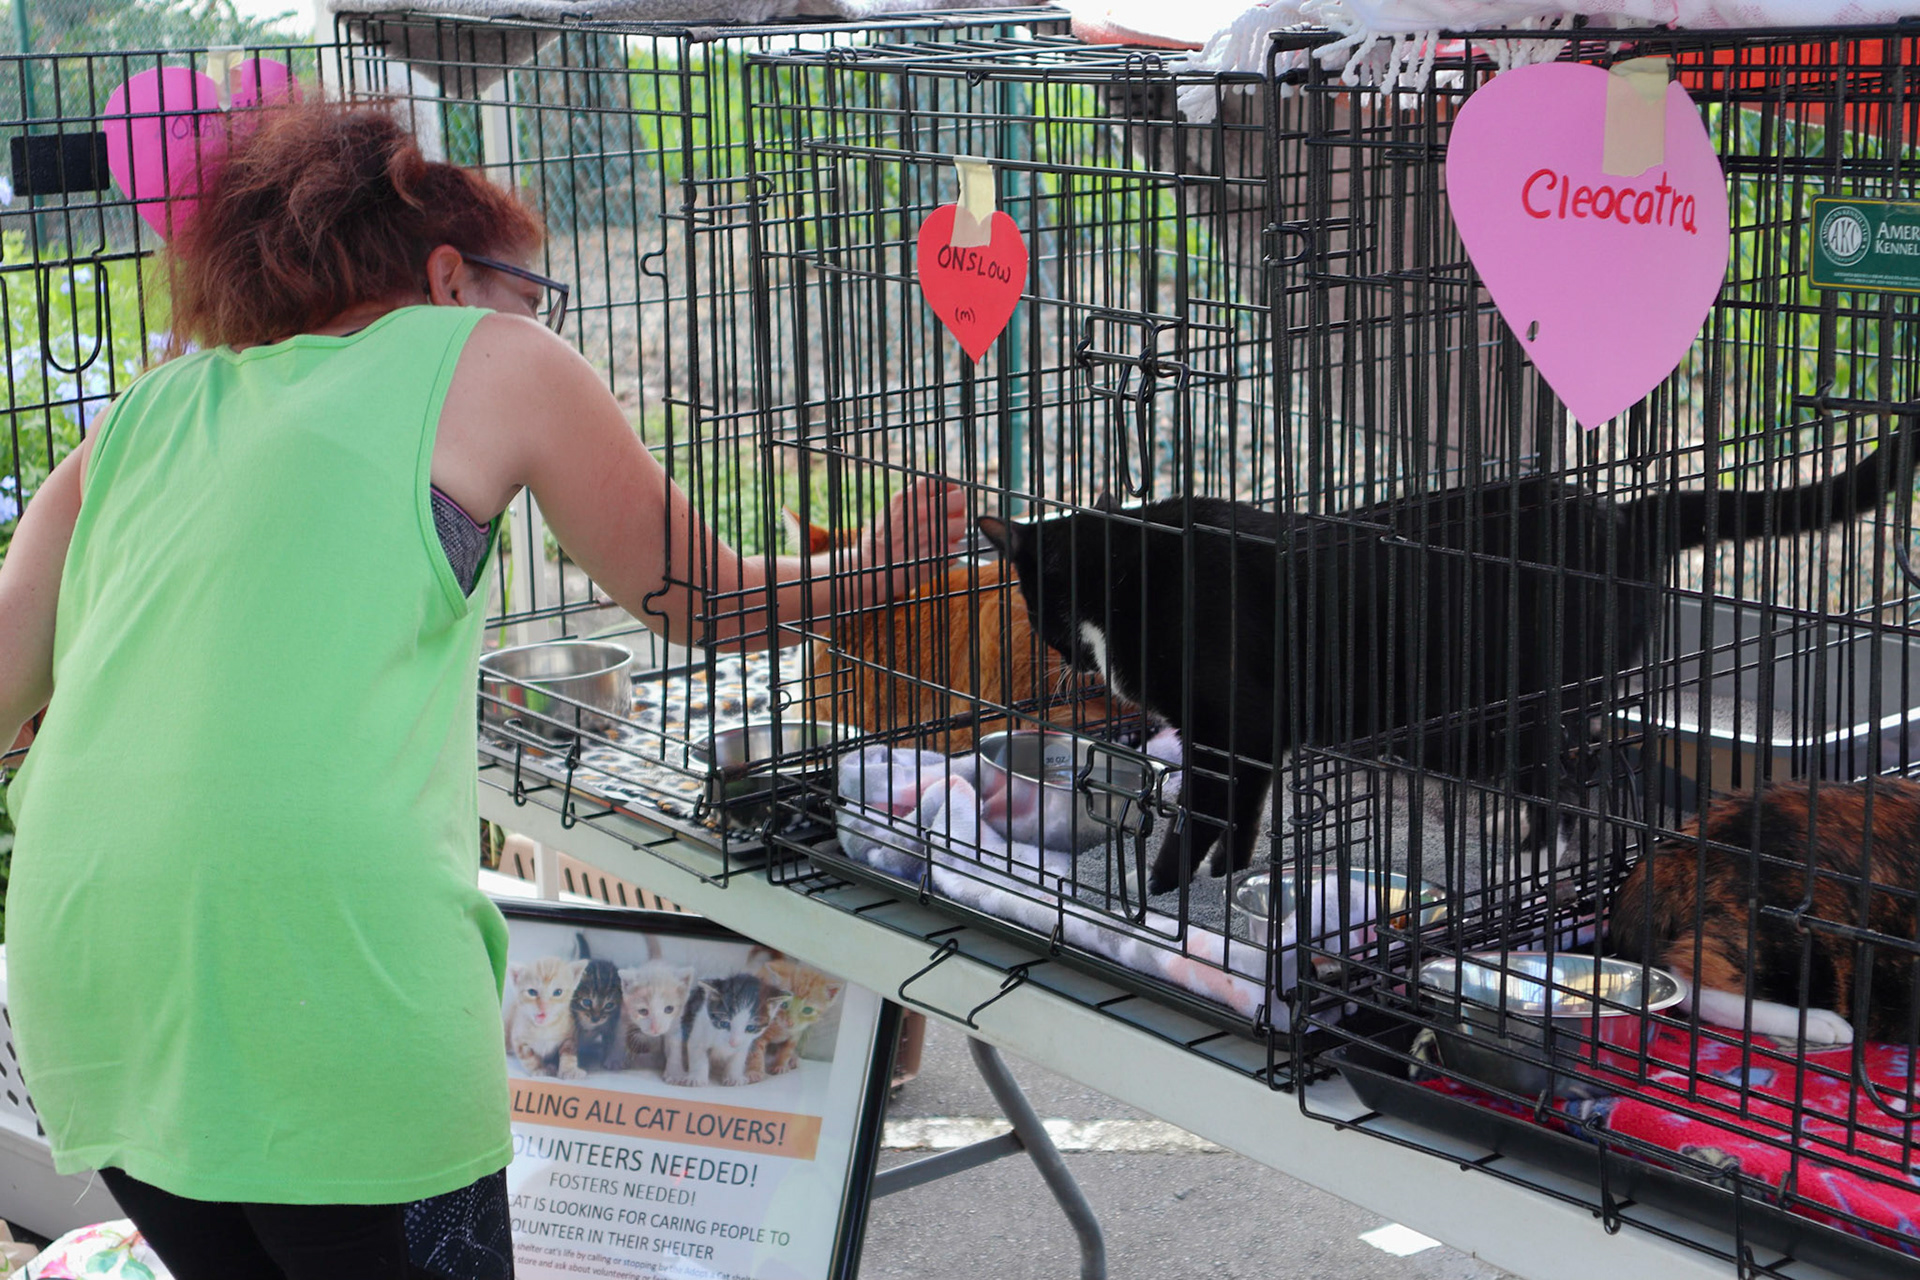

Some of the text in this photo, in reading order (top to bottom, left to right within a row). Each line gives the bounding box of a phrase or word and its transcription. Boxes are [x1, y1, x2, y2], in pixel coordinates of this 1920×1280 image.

[1521, 167, 1698, 235] Cleocatra
[1830, 219, 1862, 254] AKC
[1876, 222, 1920, 240] AMER
[937, 244, 1011, 284] ONSLOW
[511, 1090, 786, 1146] LLING ALL CAT LOVERS!
[513, 1134, 758, 1187] OLUNTEERS NEEDED!
[549, 1172, 696, 1206] FOSTERS NEEDED!
[510, 1218, 714, 1260] OLUNTEER IN THEIR SHELTER
[533, 1197, 546, 1212] IS
[549, 1200, 615, 1221] LOOKING
[617, 1209, 647, 1226] FOR
[650, 1214, 707, 1234] CARING
[710, 1222, 766, 1243] PEOPLE
[769, 1230, 791, 1246] TO
[538, 1260, 552, 1268] and
[568, 1264, 591, 1274] about
[576, 1252, 586, 1261] by
[587, 1253, 612, 1265] calling
